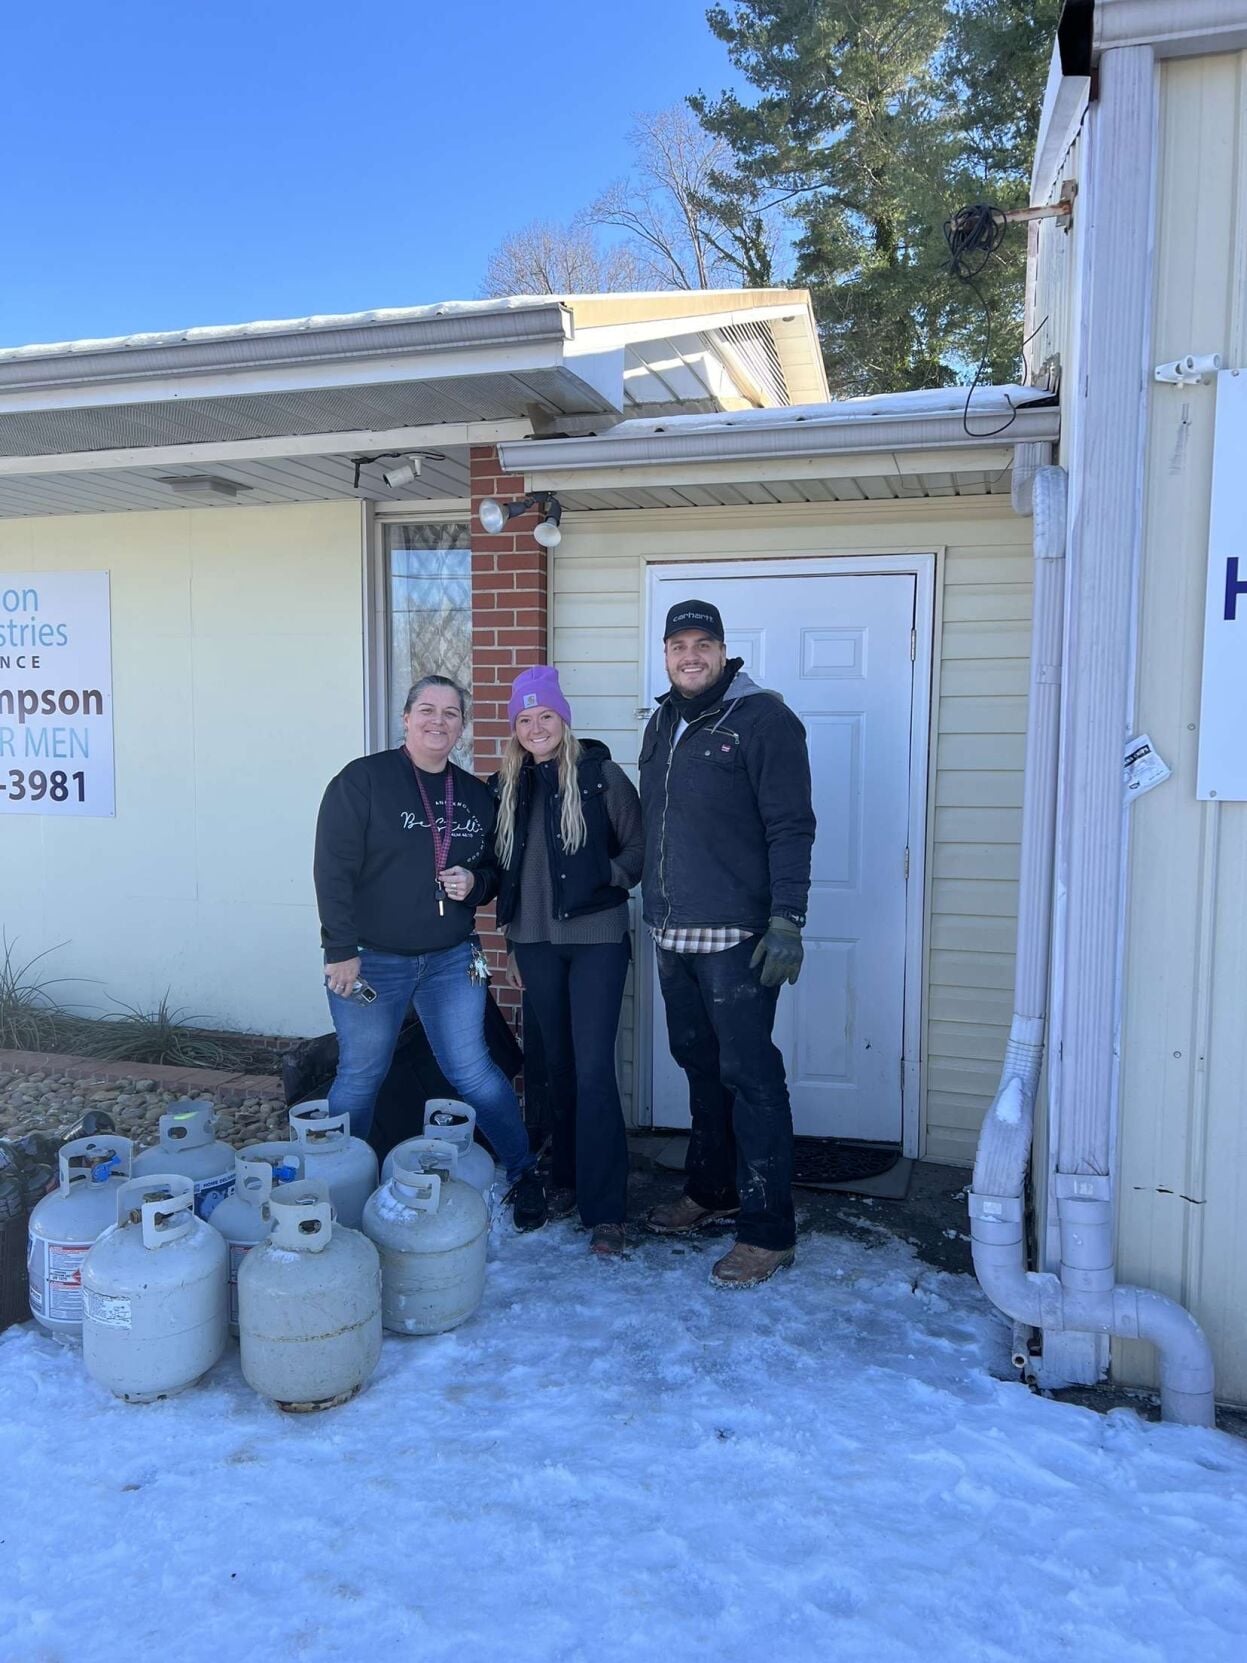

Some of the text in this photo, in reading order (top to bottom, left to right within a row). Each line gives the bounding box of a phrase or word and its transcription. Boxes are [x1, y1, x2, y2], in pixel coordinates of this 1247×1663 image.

[2, 588, 38, 612] on
[0, 655, 41, 669] NCE
[25, 727, 89, 758] MEN
[400, 811, 432, 829] Be
